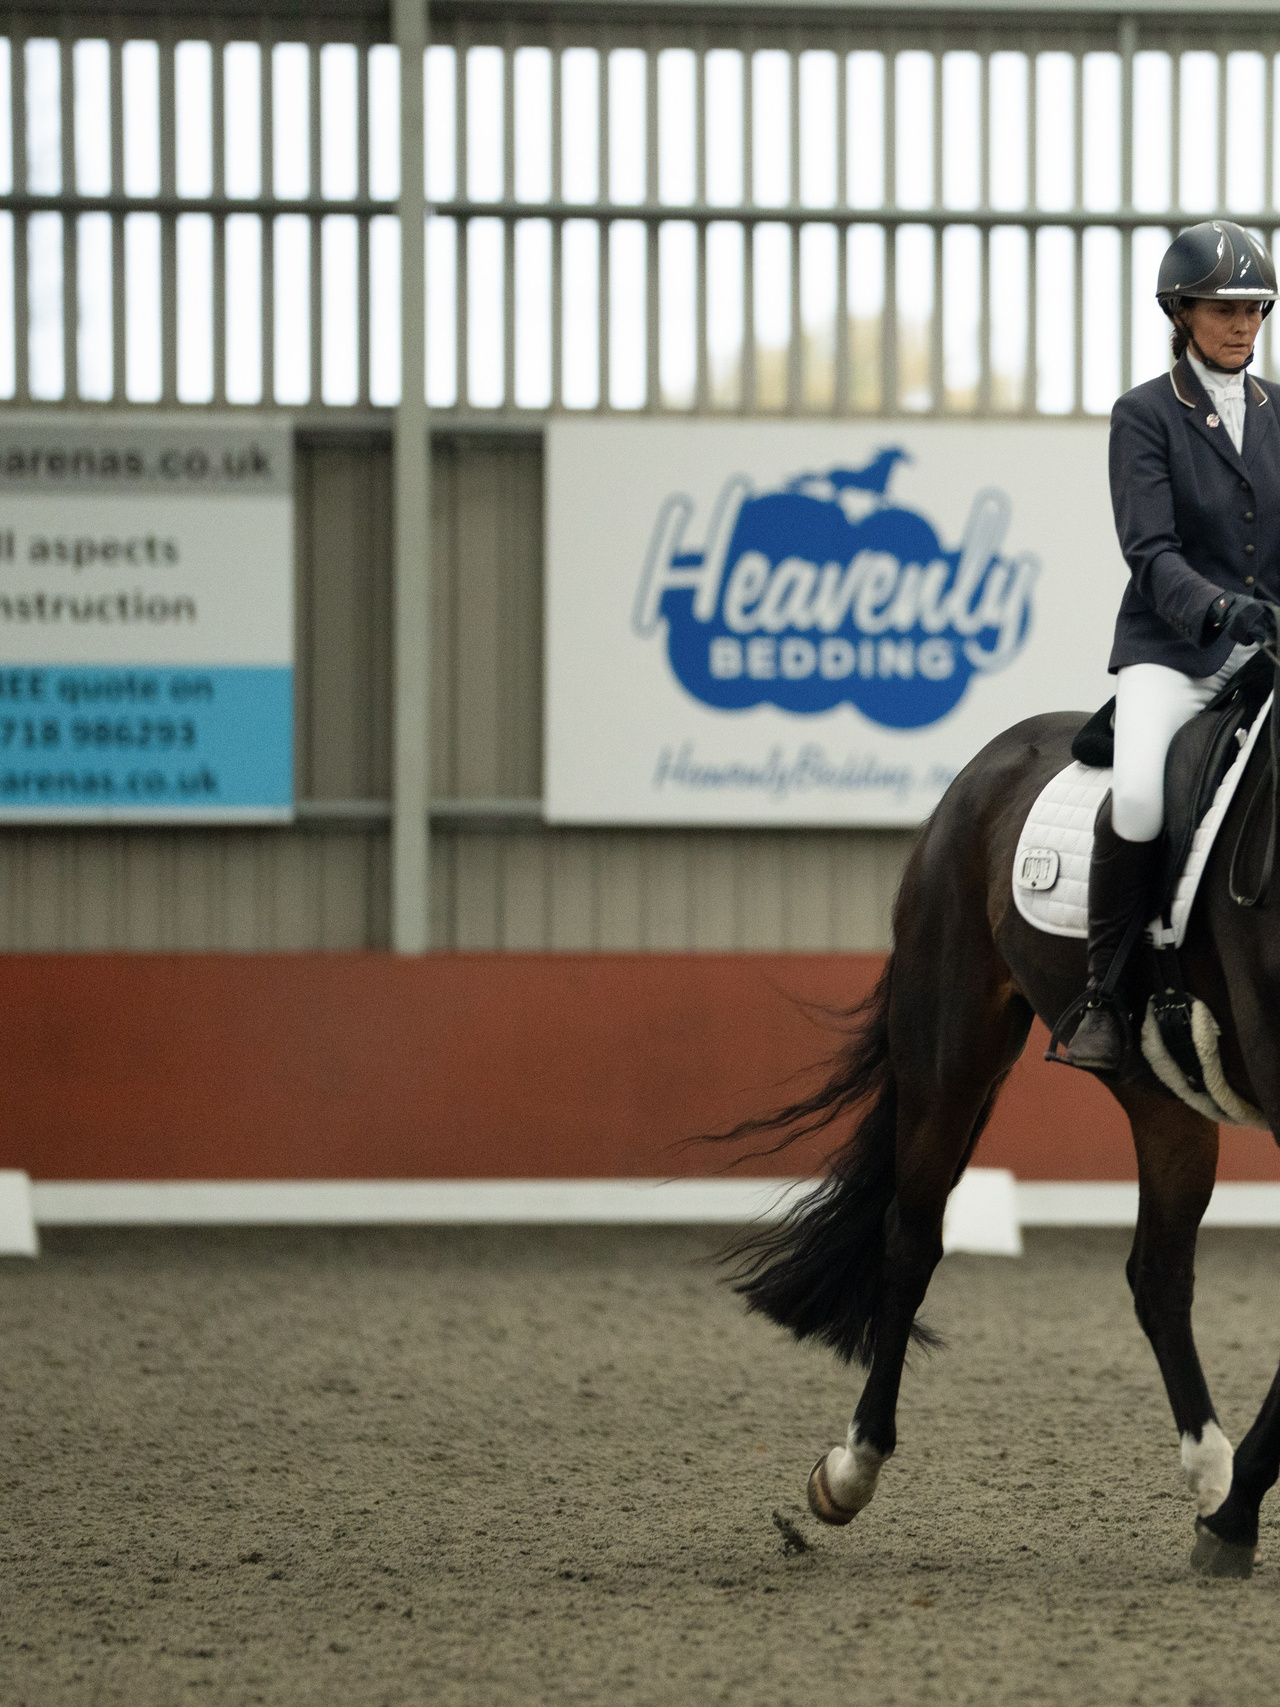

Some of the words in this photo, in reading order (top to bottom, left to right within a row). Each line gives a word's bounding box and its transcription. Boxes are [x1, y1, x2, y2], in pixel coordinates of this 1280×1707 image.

[0, 443, 270, 479] arenas.co.uk
[28, 533, 180, 571] aspects
[632, 474, 1041, 675] Heavenly
[709, 637, 956, 680] BEDDING
[57, 675, 160, 709] quote
[169, 675, 214, 699] on
